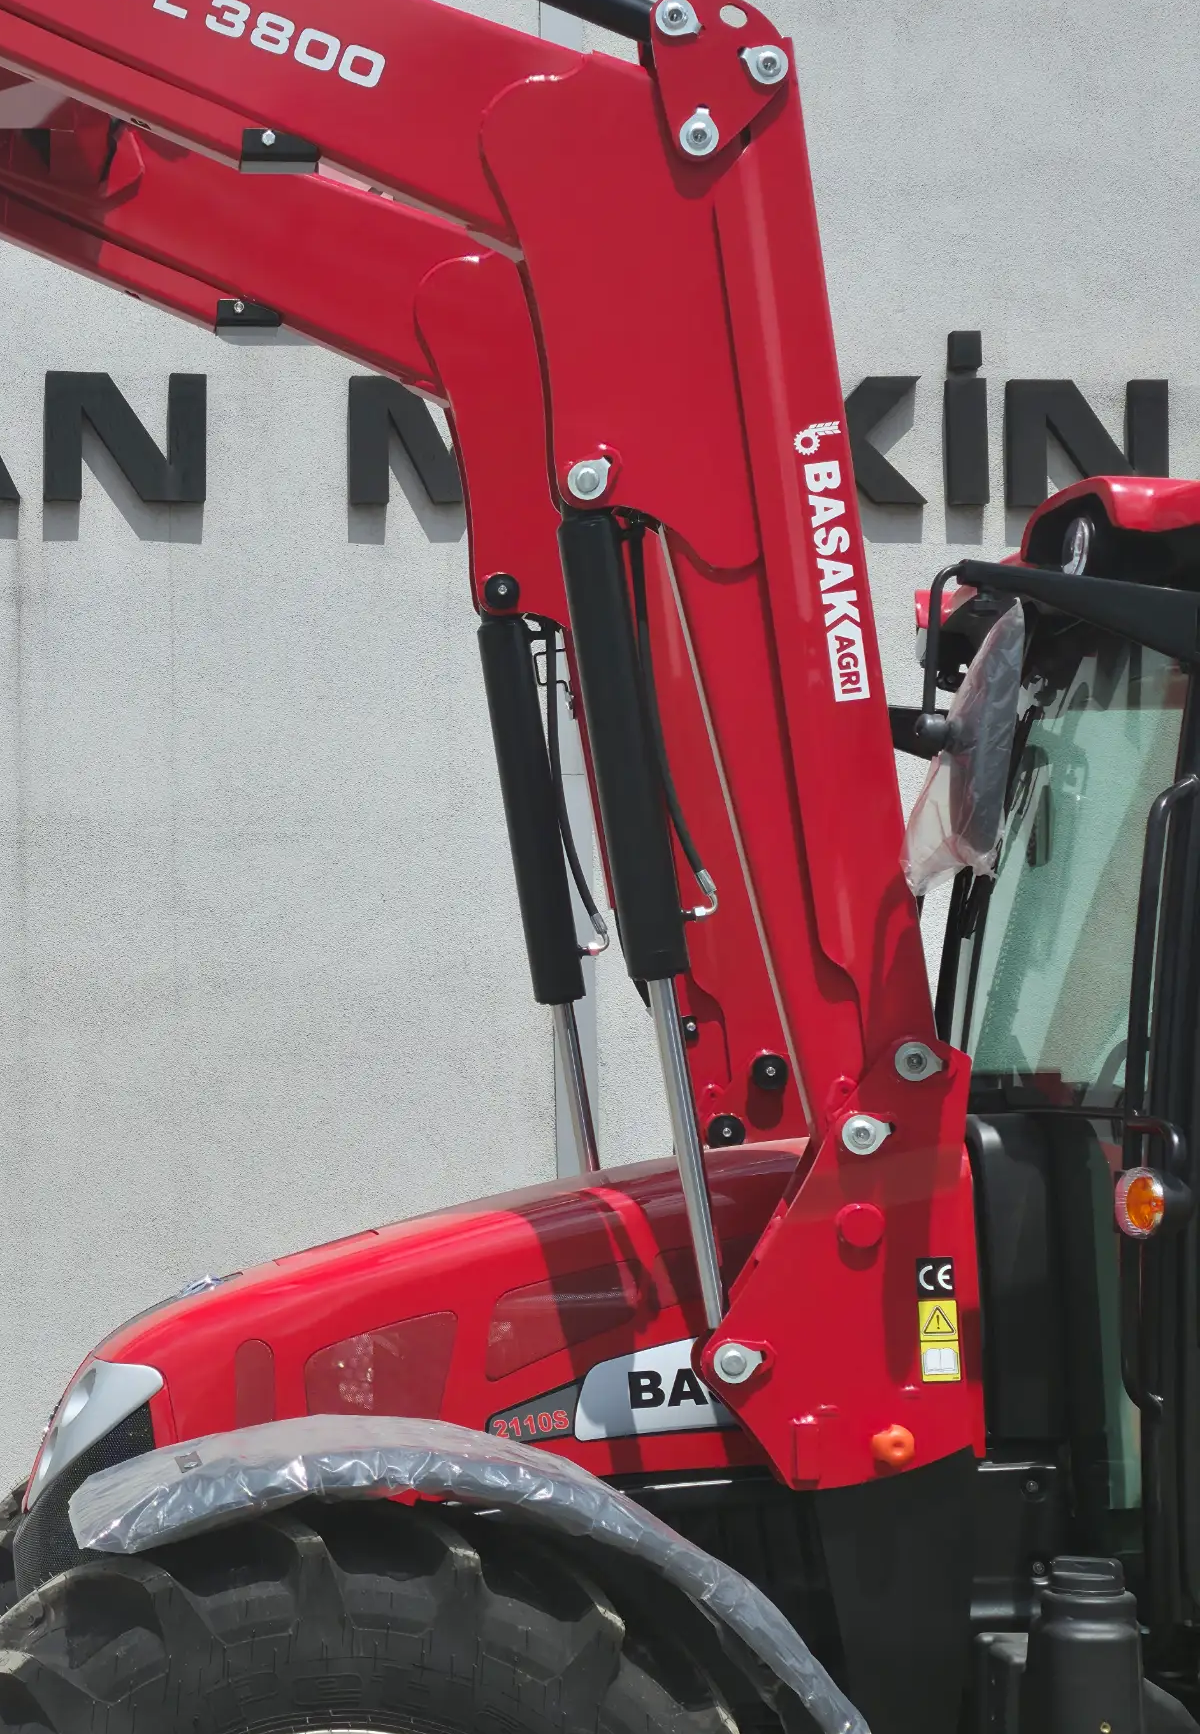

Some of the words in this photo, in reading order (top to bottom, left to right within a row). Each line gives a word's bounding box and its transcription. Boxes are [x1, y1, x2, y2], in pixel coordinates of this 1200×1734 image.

[347, 330, 1169, 508] MKİN
[834, 634, 863, 695] AGRI
[919, 1265, 953, 1291] CE
[492, 1409, 571, 1439] 2110S
[627, 1368, 721, 1410] BA
